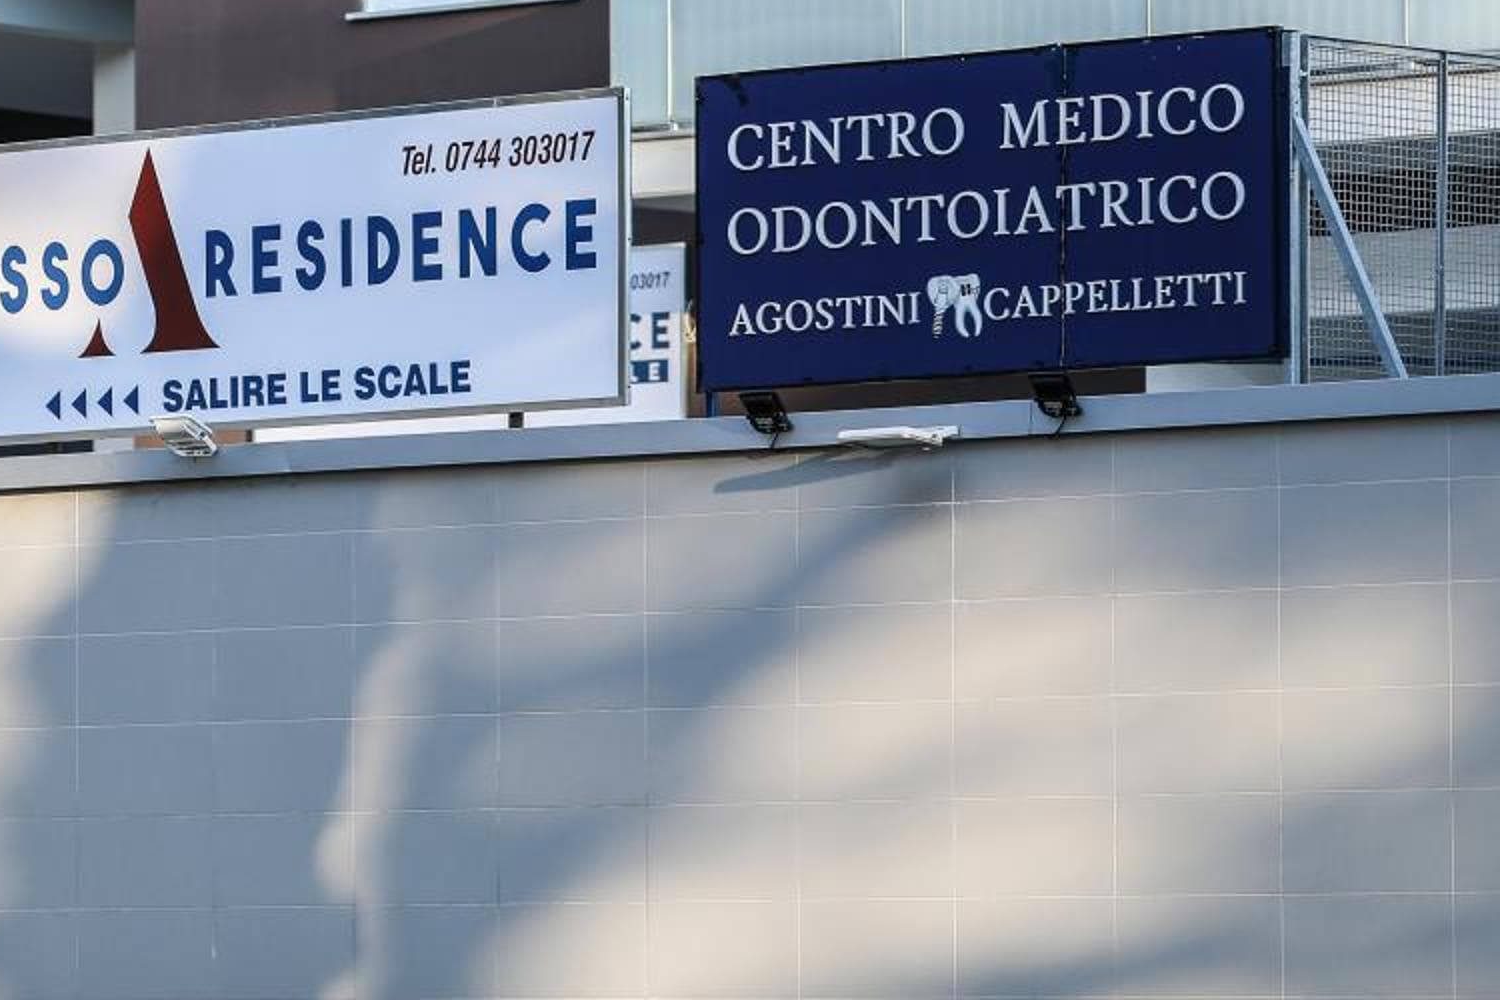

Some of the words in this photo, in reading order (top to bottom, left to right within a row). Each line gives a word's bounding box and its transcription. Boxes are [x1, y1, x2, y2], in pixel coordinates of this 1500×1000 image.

[402, 143, 437, 177] Tel.
[445, 135, 501, 171] 0744
[508, 130, 596, 166] 303017
[727, 107, 964, 170] CENTRO
[999, 83, 1245, 149] MEDICO
[204, 199, 598, 298] RESIDENCE
[727, 171, 1245, 255] ODONTOIATRICO
[729, 293, 920, 336] AGOSTINI
[983, 271, 1247, 320] CAPPELLETTI
[162, 374, 286, 413] SALIRE
[300, 370, 341, 402] LE
[353, 360, 472, 399] SCALE
